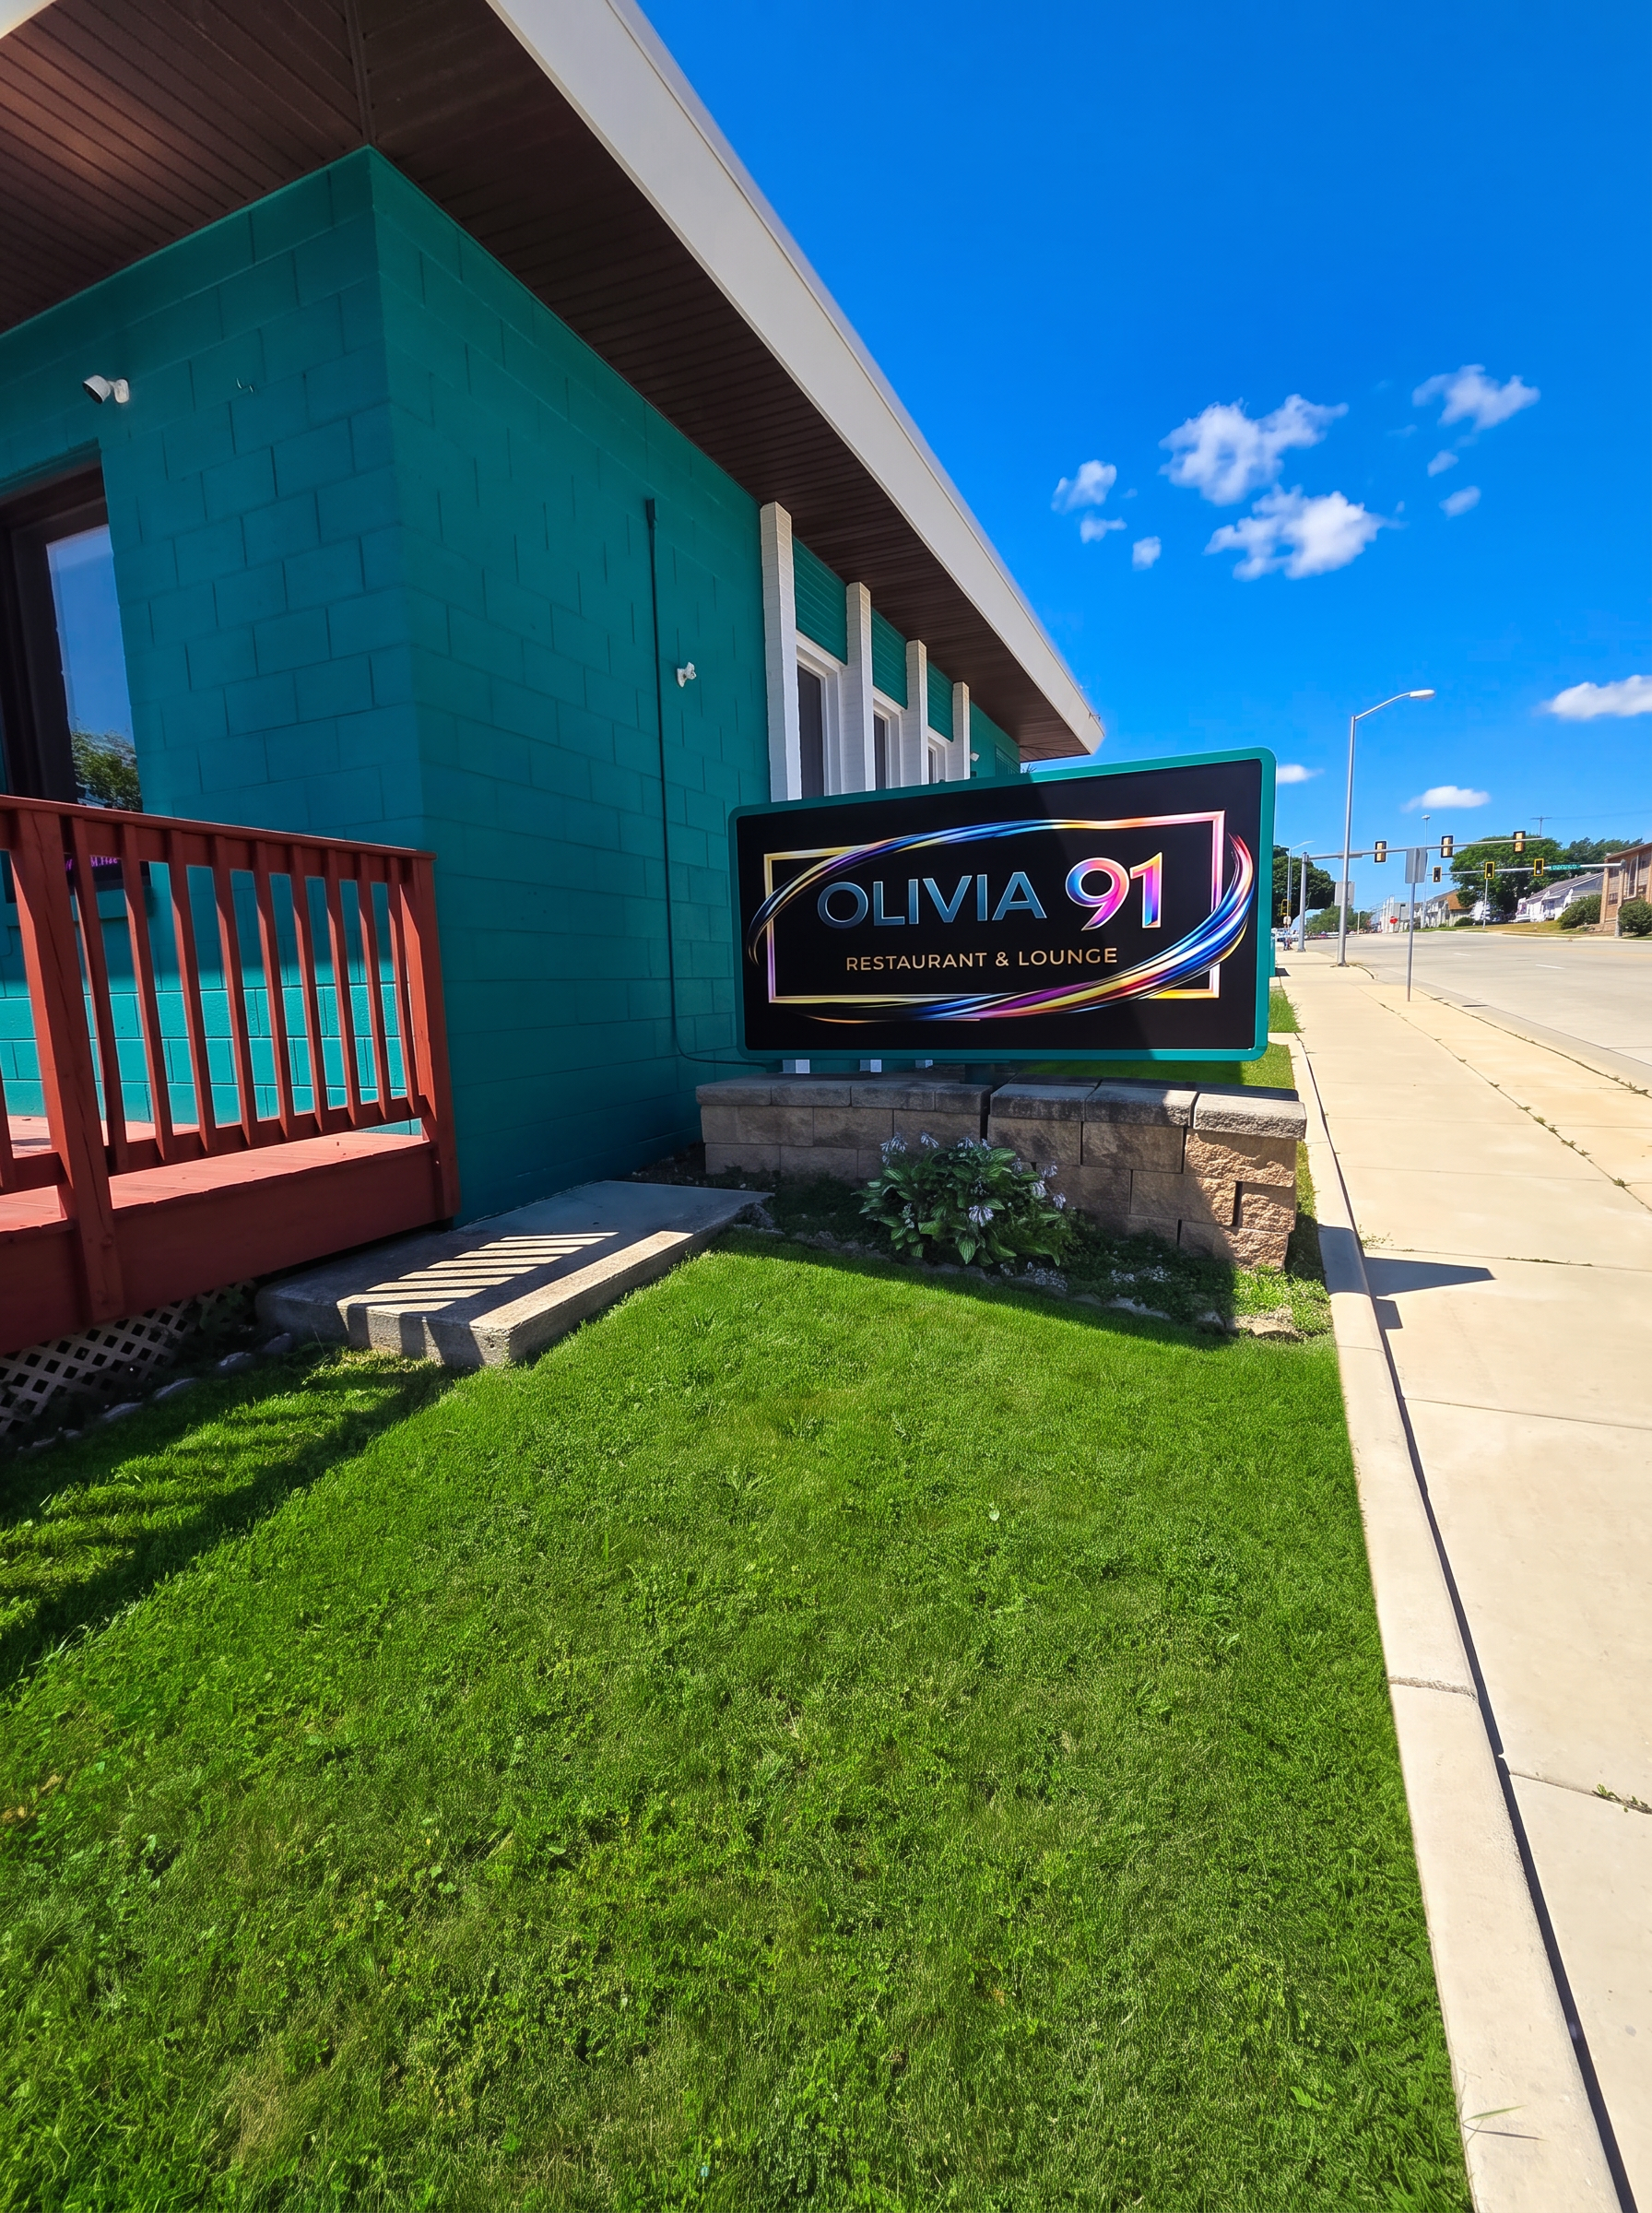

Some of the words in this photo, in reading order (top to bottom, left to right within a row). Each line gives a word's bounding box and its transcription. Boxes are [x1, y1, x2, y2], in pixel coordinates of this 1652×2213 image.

[817, 871, 1047, 929] OLIVIA
[1065, 852, 1162, 931] 91
[846, 953, 987, 971] RESTAURANT
[995, 952, 1009, 966] &
[1018, 948, 1118, 965] LOUNGE
